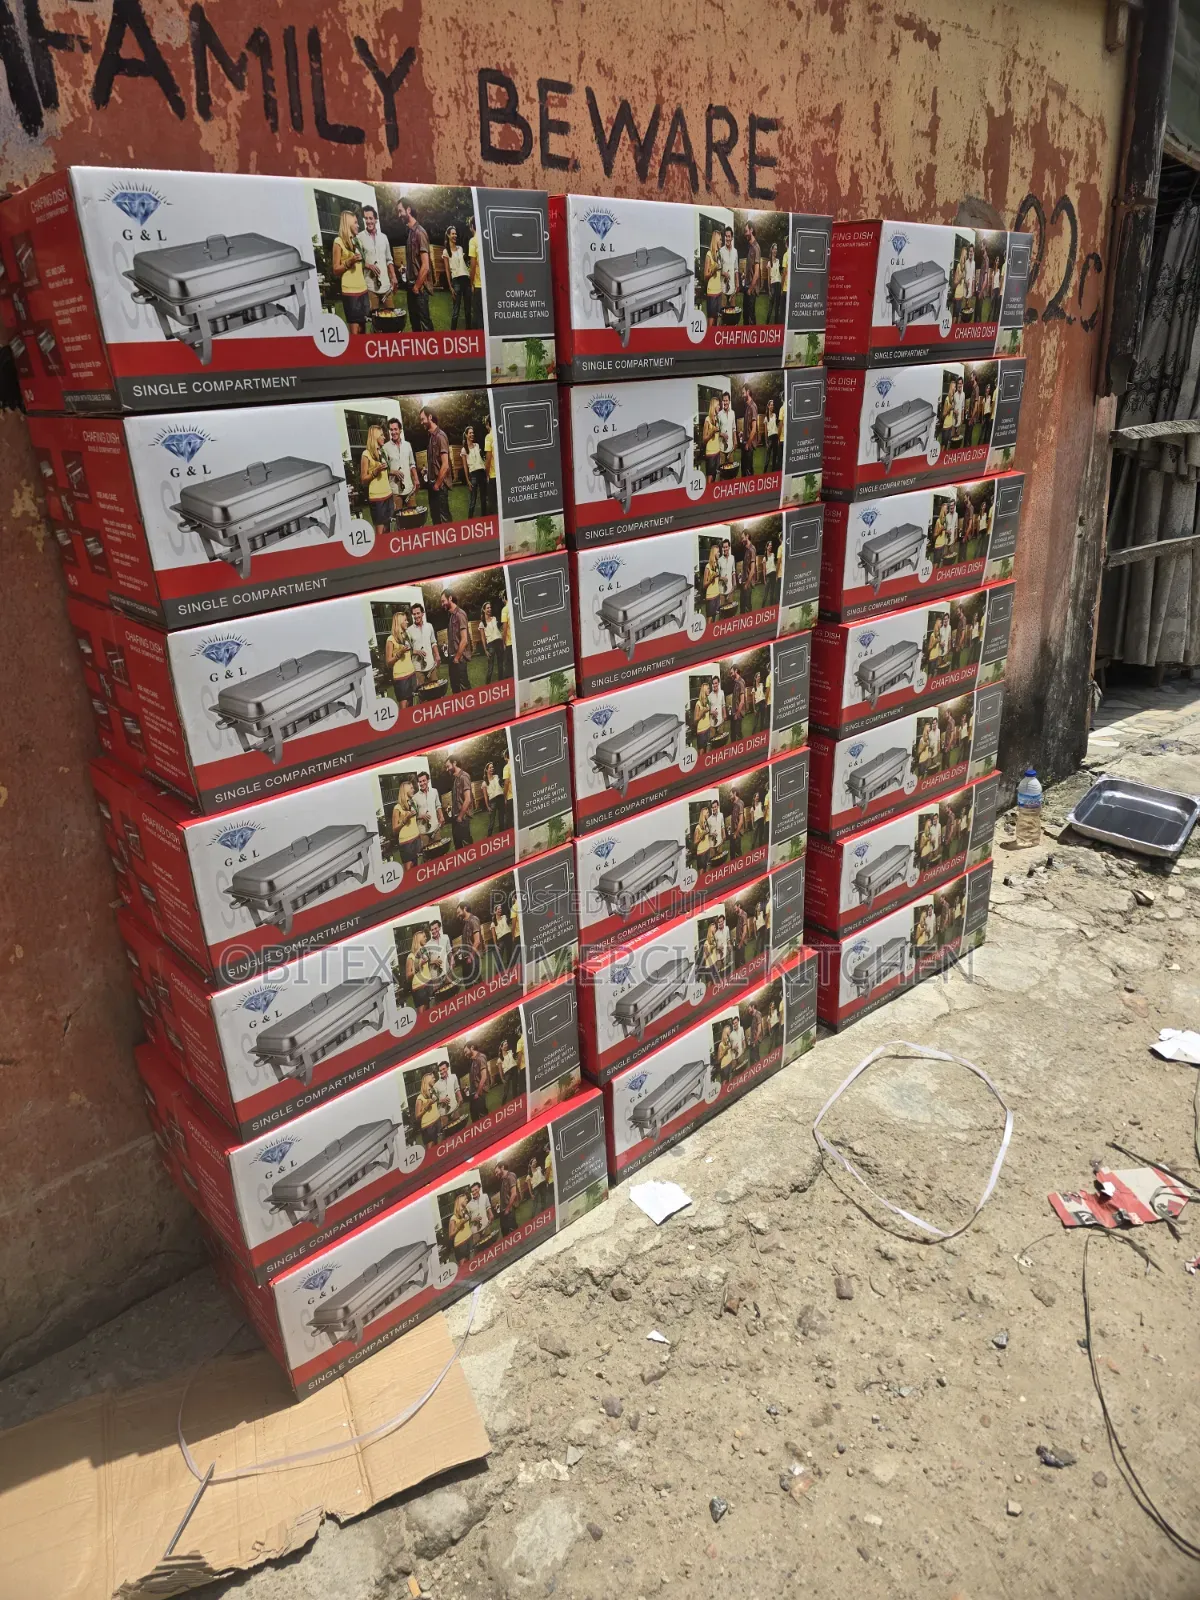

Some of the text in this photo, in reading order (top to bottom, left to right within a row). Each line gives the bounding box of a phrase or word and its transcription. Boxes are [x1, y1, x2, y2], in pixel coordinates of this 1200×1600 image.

[20, 0, 416, 152] FAMILY
[478, 68, 783, 201] BEWARE
[505, 289, 536, 298] COMPACT
[319, 328, 344, 343] 12L
[690, 321, 704, 333] 12L
[715, 329, 781, 345] CHAFING DISH
[364, 336, 479, 359] CHAFING DISH
[582, 357, 674, 371] SINGLE COMPARTMENT
[132, 375, 298, 397] SINGLE COMPARTMENT
[690, 479, 703, 491] 12L
[713, 475, 778, 499] CHAFING DISH
[348, 529, 371, 546] 12L
[389, 520, 494, 554] CHAFING DISH
[585, 515, 674, 541] SINGLE COMPARTMENT
[178, 597, 228, 616] SINGLE
[231, 577, 328, 605] COMPARTMENT
[690, 620, 703, 633] 12L
[713, 608, 775, 637] CHAFING DISH
[591, 656, 675, 689] SINGLE COMPARTMENT
[373, 705, 394, 722] 12L
[411, 683, 509, 725] CHAFING DISH
[682, 753, 694, 766] 12L
[705, 733, 766, 767] CHAFING DISH
[215, 753, 355, 804] SINGLE COMPARTMENT
[586, 789, 668, 828] SINGLE COMPARTMENT
[416, 833, 510, 883] CHAFING DISH
[705, 848, 765, 886] CHAFING DISH
[380, 867, 400, 885] 12L
[683, 873, 695, 887] 12L
[227, 915, 361, 979] SINGLE COMPARTMENT
[749, 954, 766, 974] DISH
[428, 970, 517, 1025] CHAFING DISH
[692, 987, 703, 1001] 12L
[394, 1012, 413, 1030] 12L
[728, 1049, 780, 1095] CHAFING DISH
[252, 1061, 376, 1131] SINGLE COMPARTMENT
[708, 1085, 719, 1100] 12L
[436, 1100, 522, 1161] CHAFING DISH
[403, 1150, 421, 1169] 12L
[625, 1123, 696, 1179] SINGLE COMPARTMENT
[268, 1199, 387, 1275] SINGLE COMPARTMENT
[468, 1213, 551, 1275] CHAFING DISH
[437, 1267, 454, 1285] 12L
[309, 1314, 421, 1392] SINGLE COMPARTMENT
